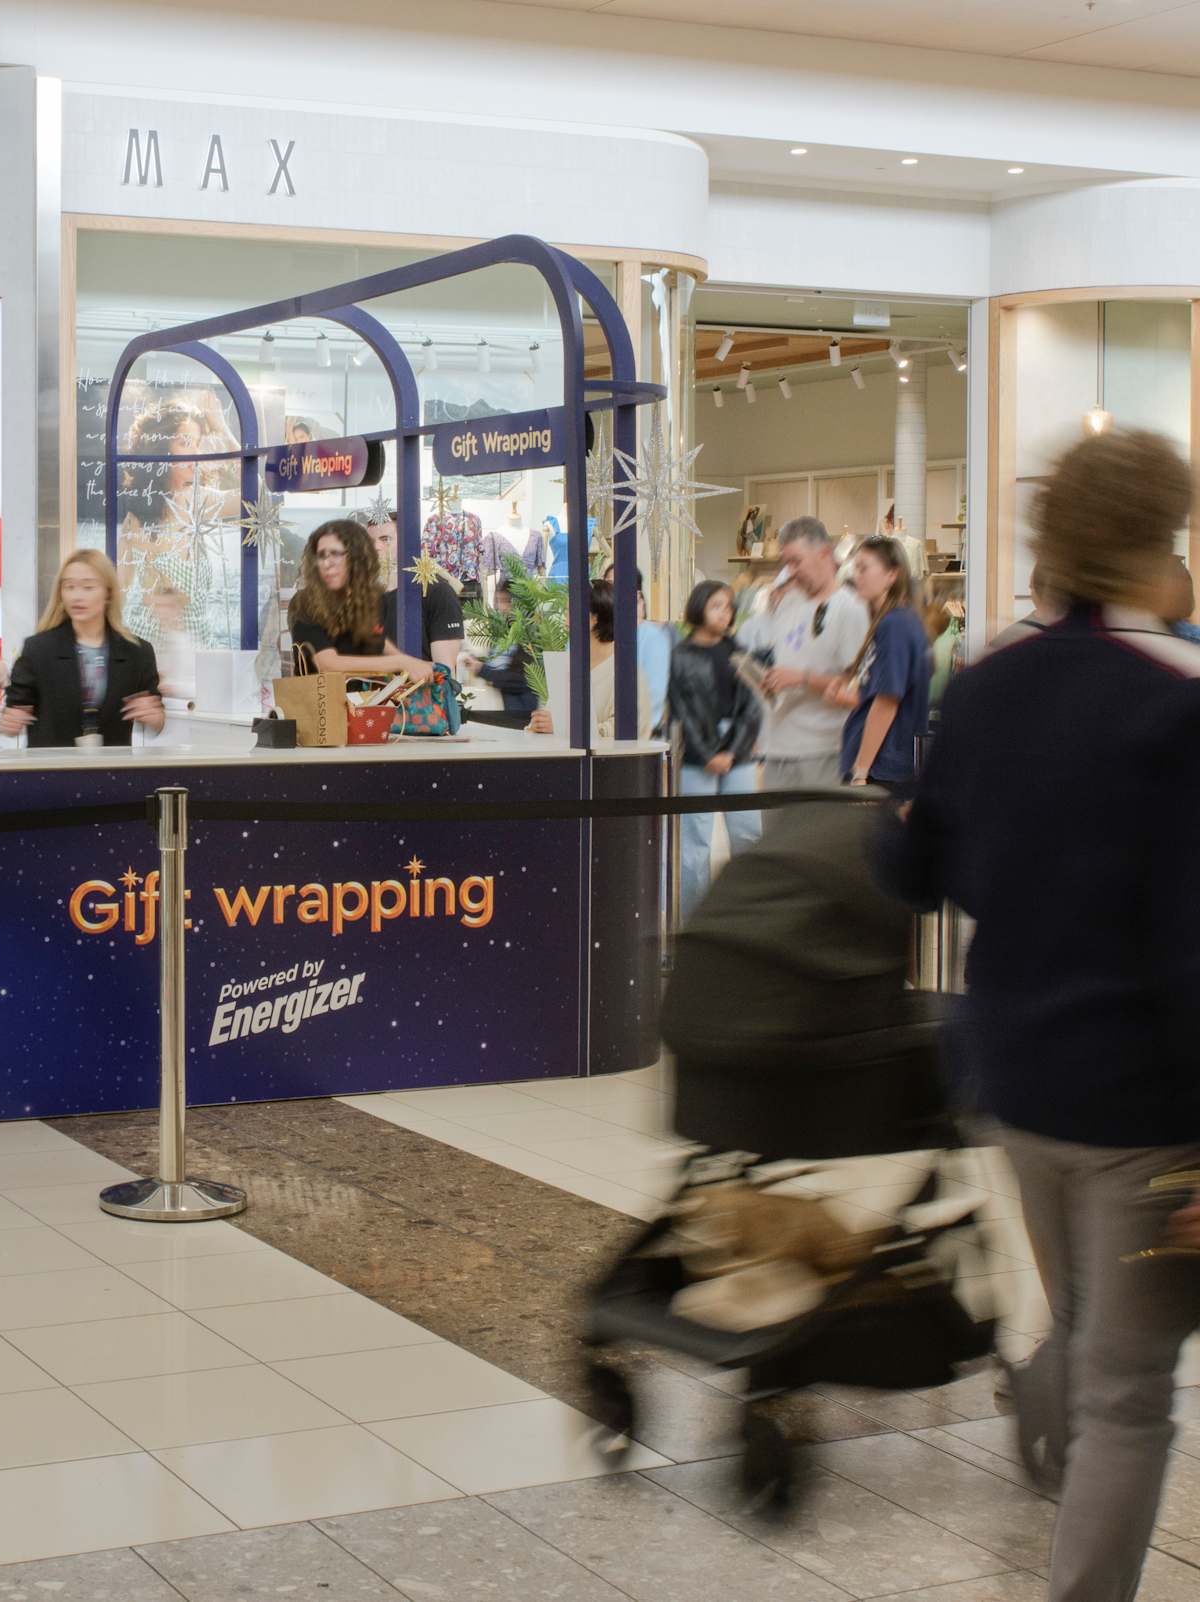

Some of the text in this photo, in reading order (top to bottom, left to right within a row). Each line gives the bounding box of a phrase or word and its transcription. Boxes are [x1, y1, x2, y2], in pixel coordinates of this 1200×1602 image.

[123, 128, 296, 196] MAX
[279, 451, 353, 480] Gift Wrapping
[452, 427, 552, 463] Gift Wrapping
[316, 672, 327, 745] GLASSONS
[213, 854, 495, 935] wrapping
[208, 972, 366, 1047] Energizer
[219, 959, 325, 1003] Powered by
